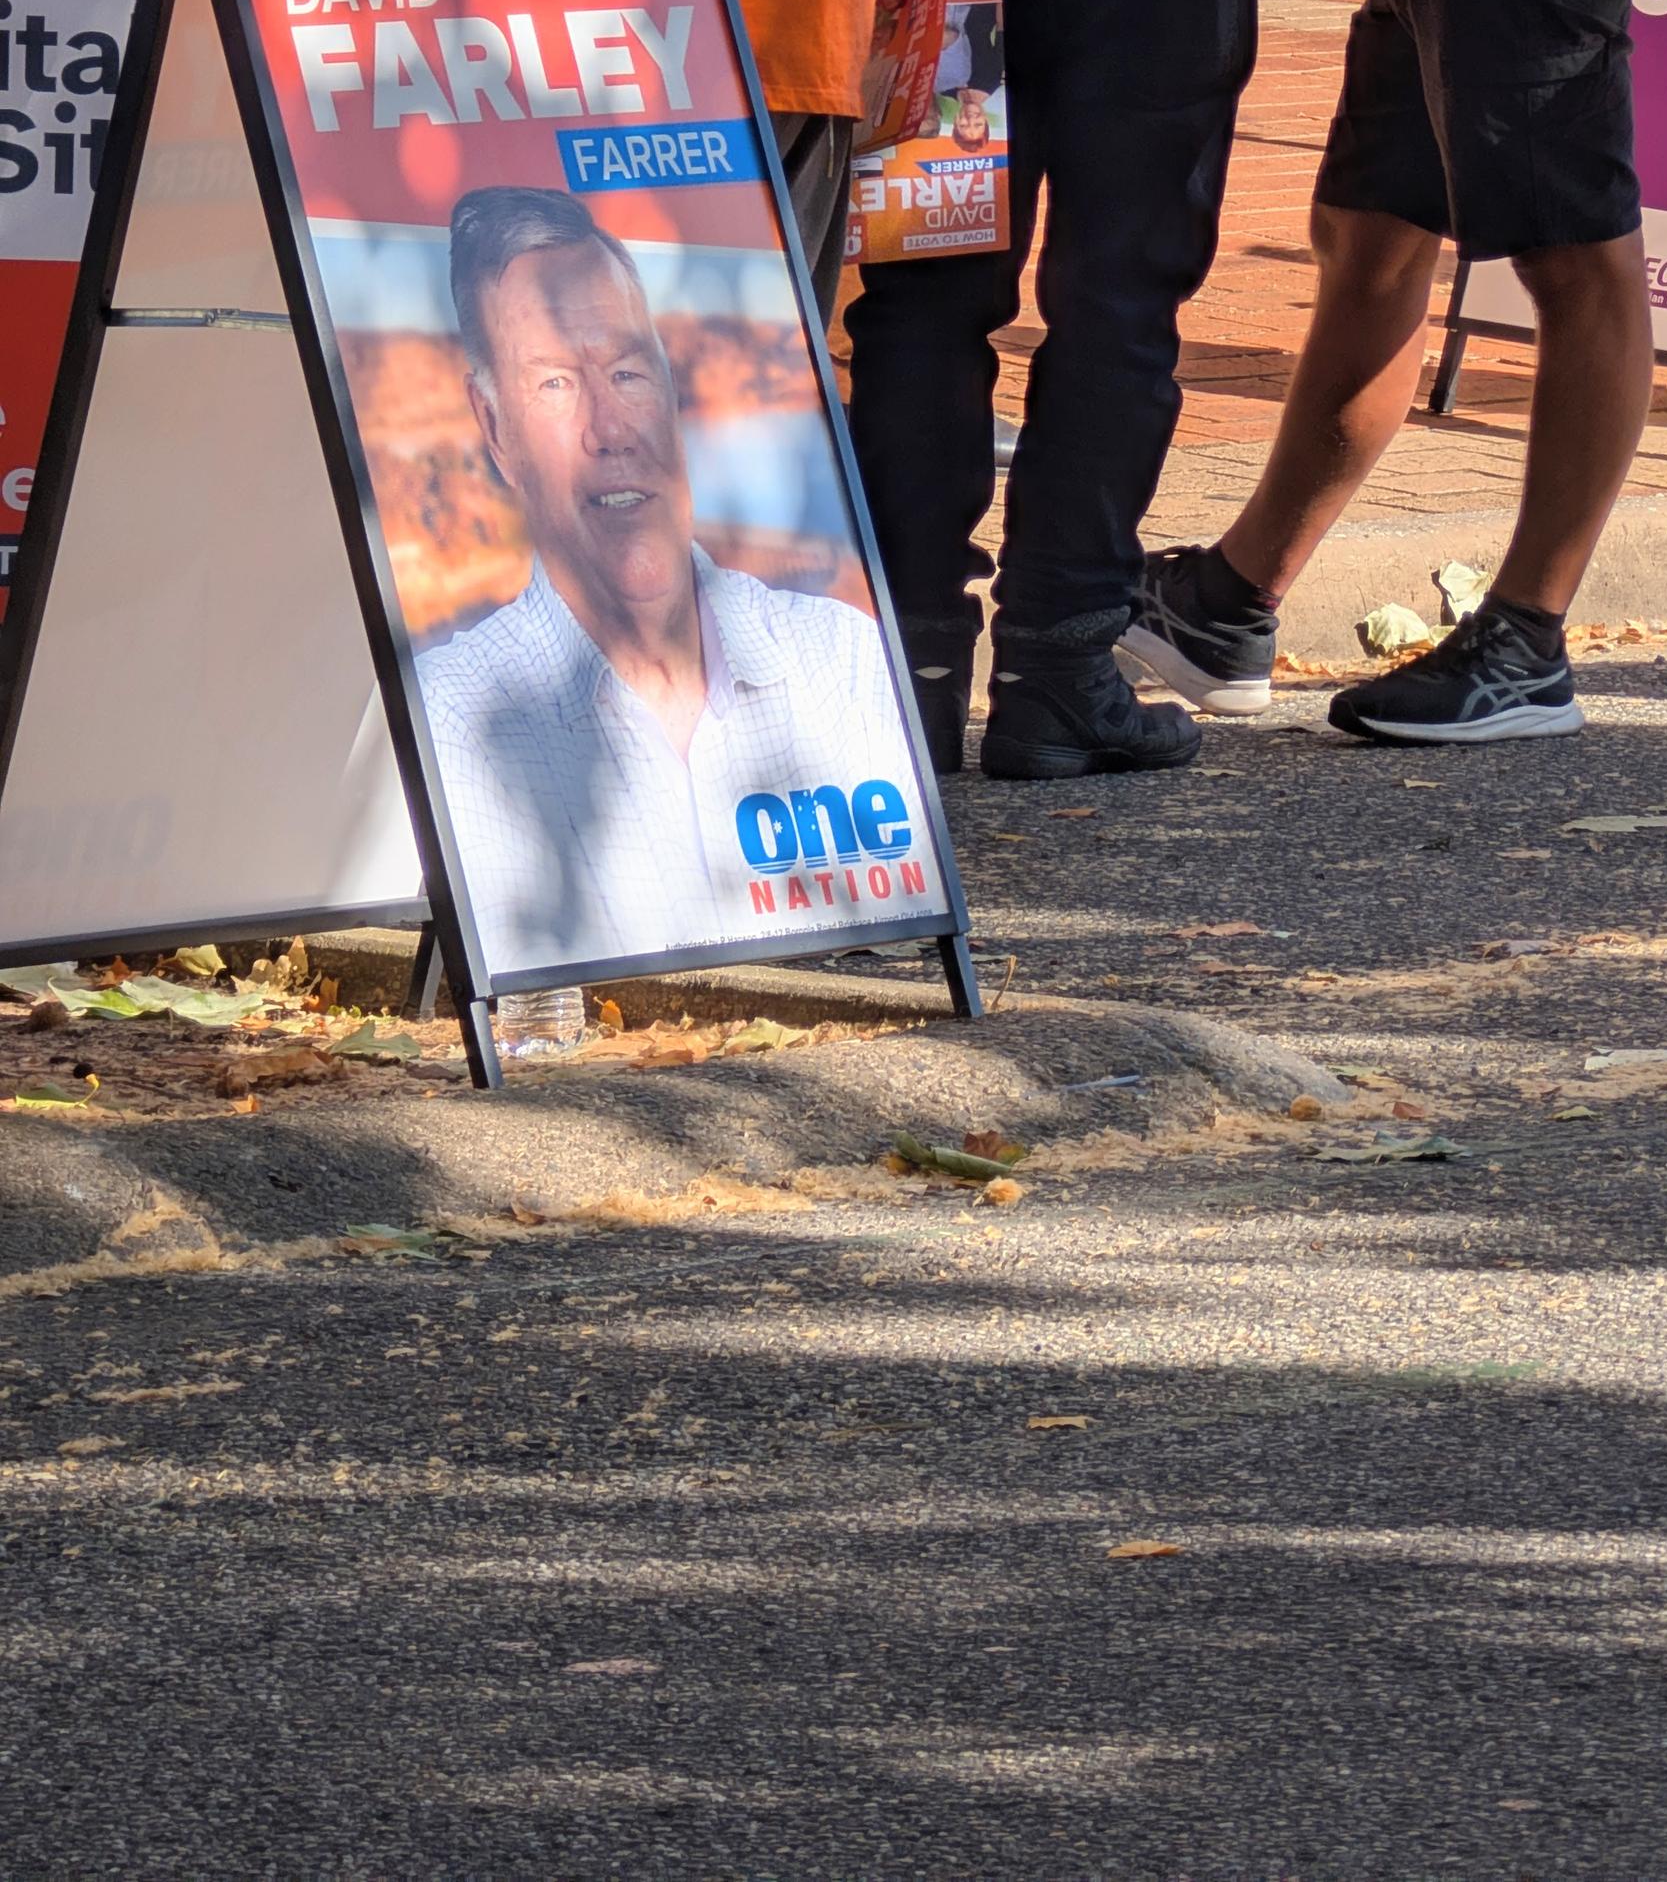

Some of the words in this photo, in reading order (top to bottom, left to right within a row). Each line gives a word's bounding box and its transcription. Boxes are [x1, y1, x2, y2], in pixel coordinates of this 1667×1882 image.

[291, 5, 695, 133] FARLEY
[0, 100, 105, 195] Sit
[573, 130, 734, 182] FARRER
[930, 158, 994, 173] FARRER
[925, 204, 996, 228] DAVID
[905, 234, 939, 248] VOTE
[942, 232, 959, 244] TO
[961, 229, 995, 242] HOW
[735, 778, 914, 876] one
[749, 861, 927, 915] NATION
